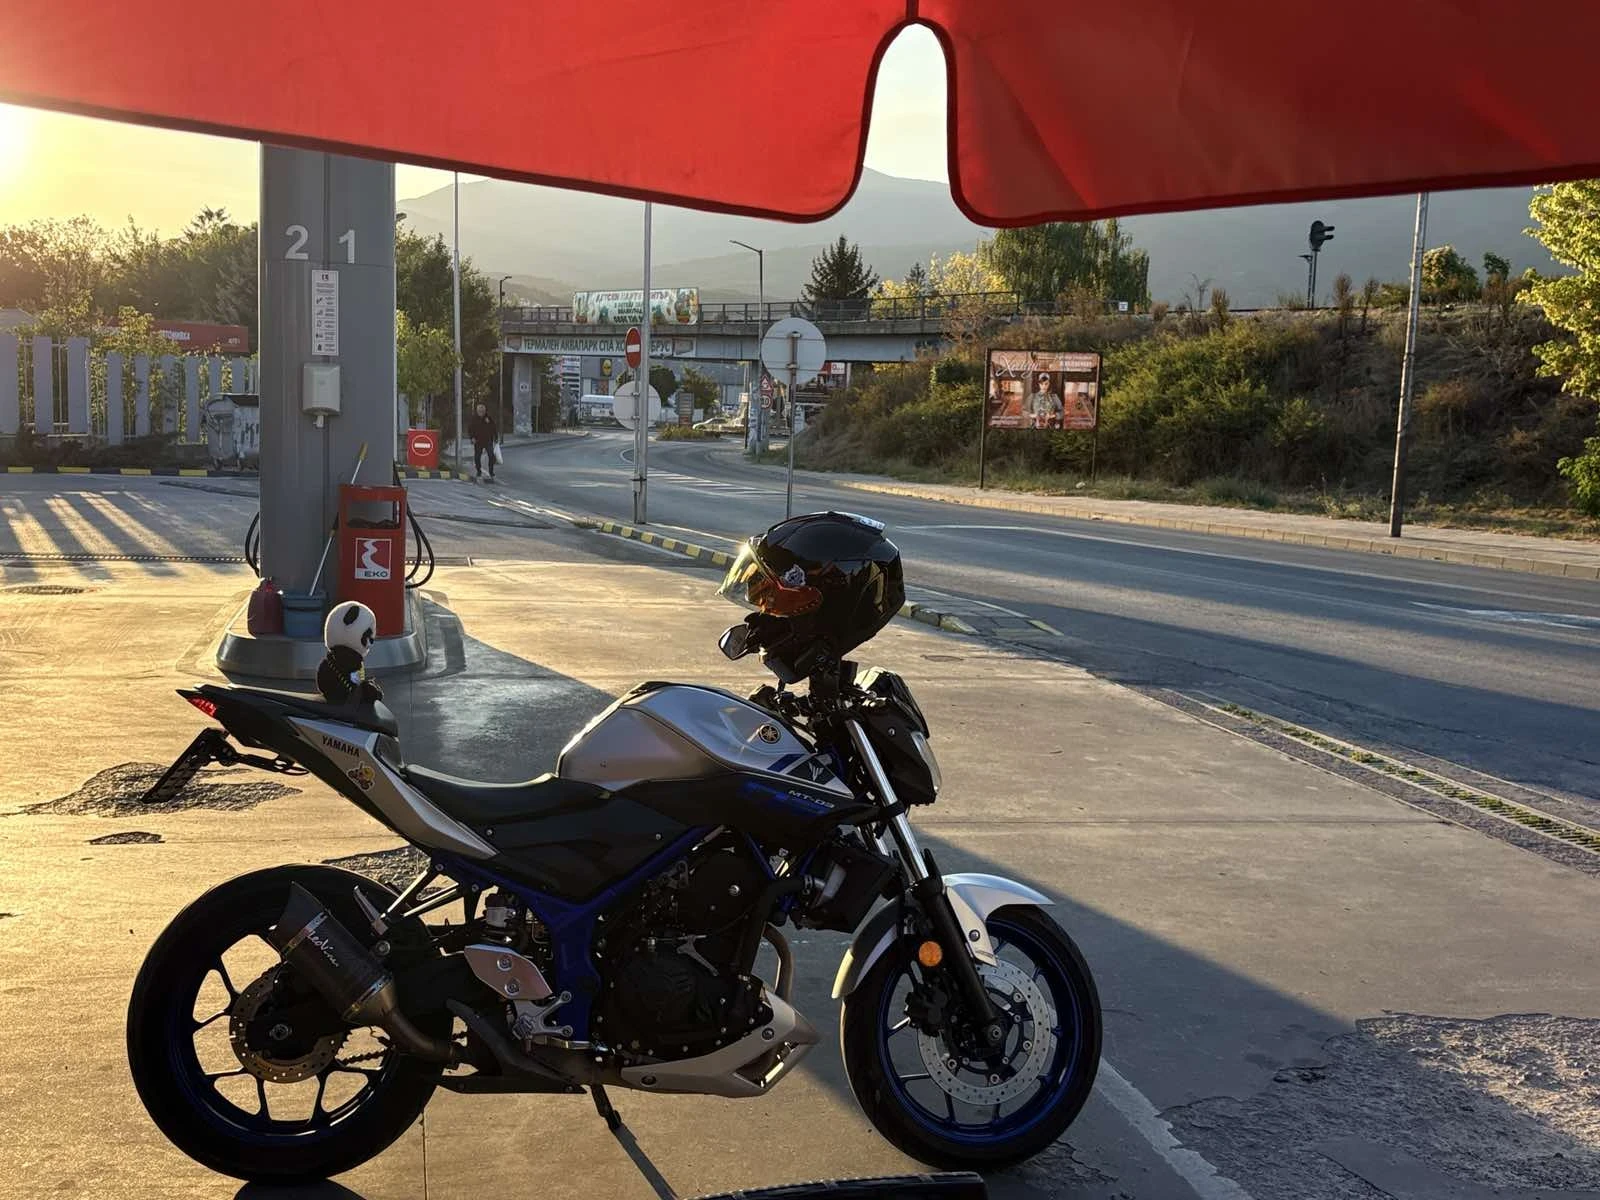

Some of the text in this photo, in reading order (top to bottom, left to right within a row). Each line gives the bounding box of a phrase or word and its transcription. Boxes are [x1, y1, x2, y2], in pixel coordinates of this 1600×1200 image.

[285, 225, 355, 264] 2 1
[524, 338, 559, 351] ТЕРМАЛЕН
[560, 339, 598, 352] АКВАПАРК
[599, 339, 614, 352] СПА
[364, 570, 388, 578] EKO
[322, 735, 360, 757] YAMAHA
